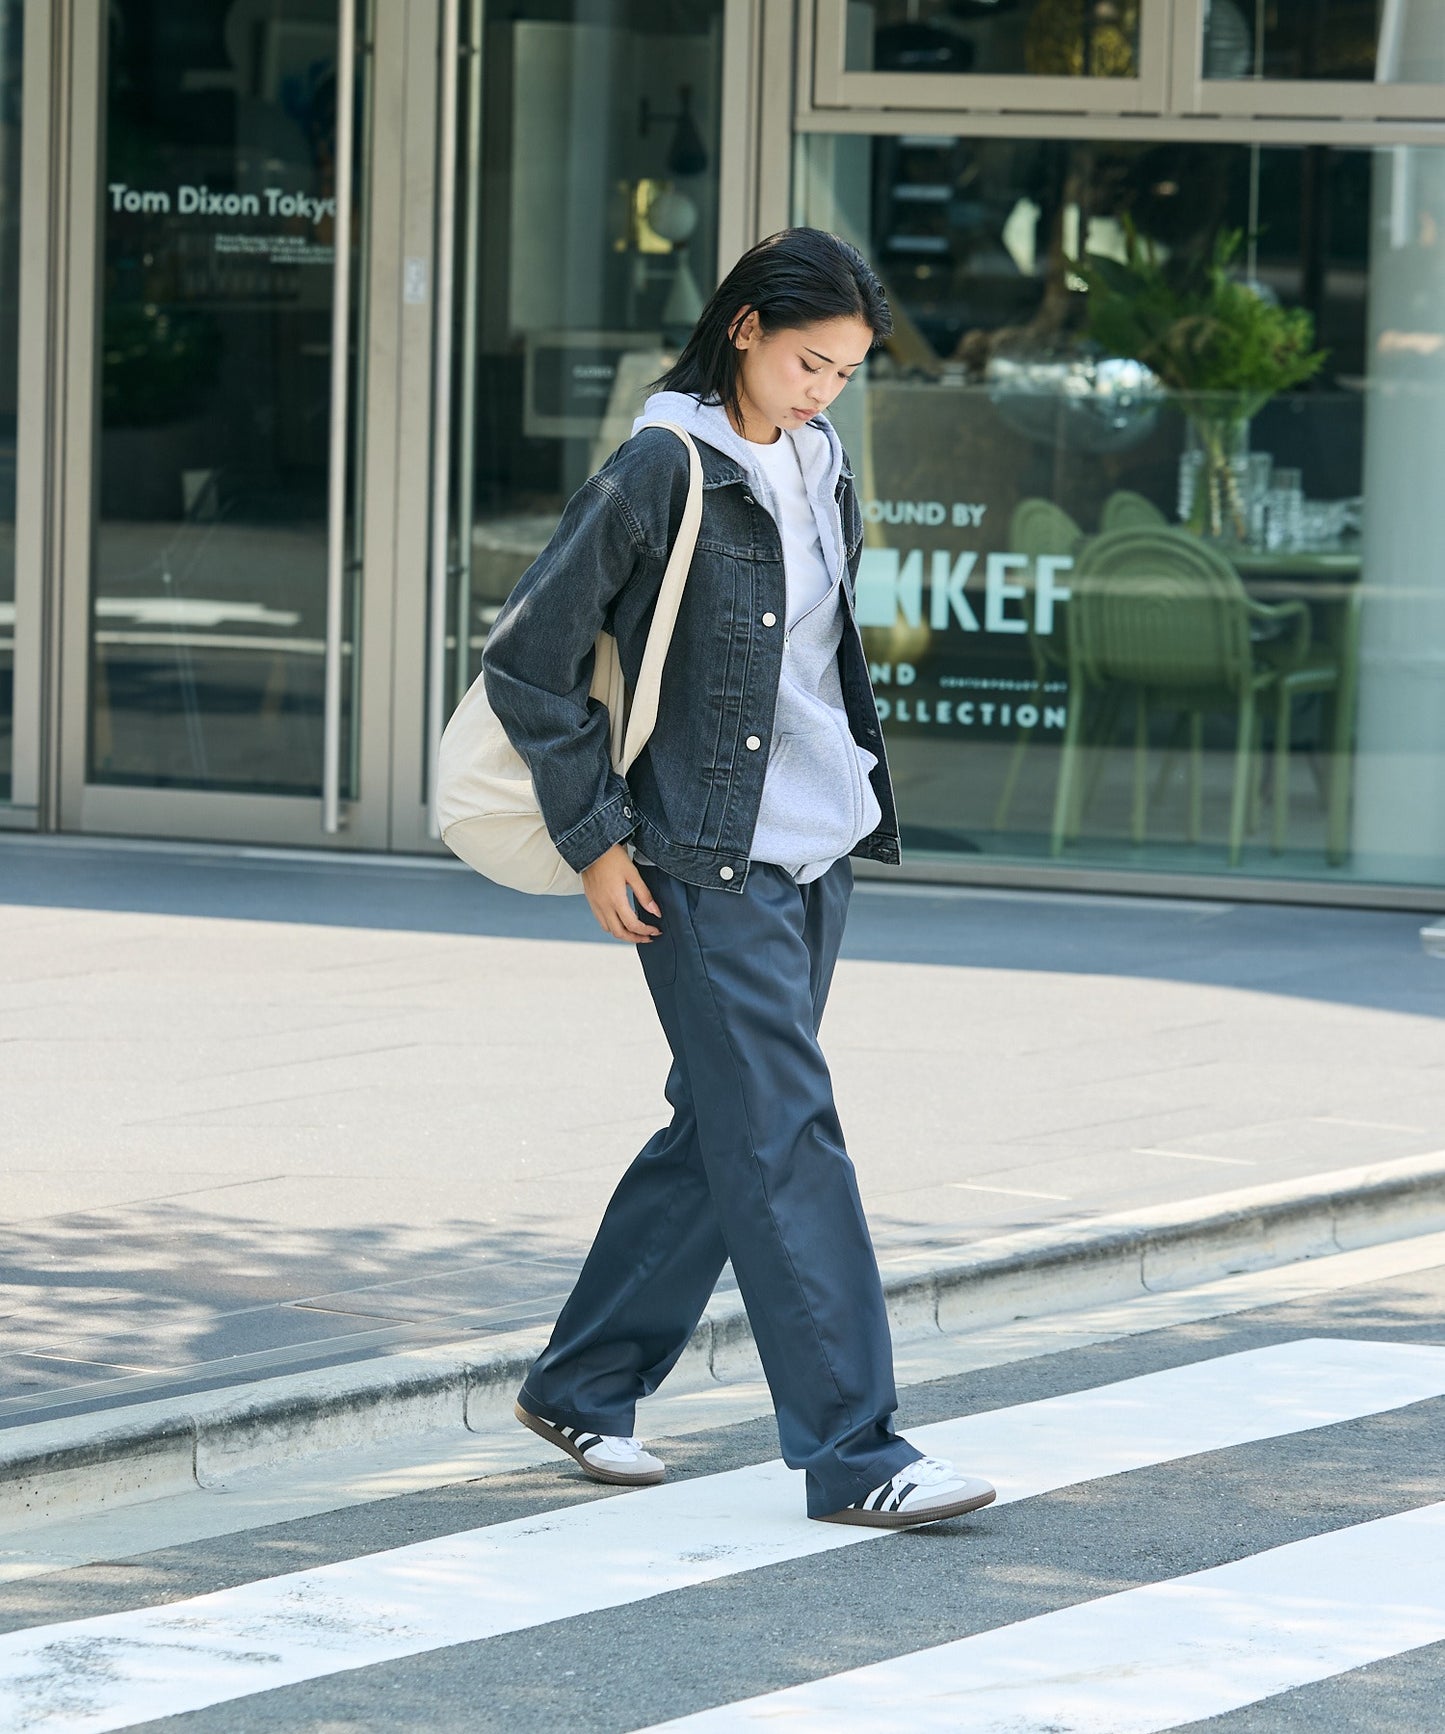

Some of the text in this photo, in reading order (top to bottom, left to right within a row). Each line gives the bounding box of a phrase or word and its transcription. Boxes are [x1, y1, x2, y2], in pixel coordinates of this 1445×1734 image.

[109, 184, 169, 212] Tom
[178, 186, 259, 216] Dixon
[865, 501, 986, 528] OUND BY
[931, 550, 1074, 635] KEF
[870, 663, 916, 686] ND
[876, 698, 1066, 729] OLLECTION
